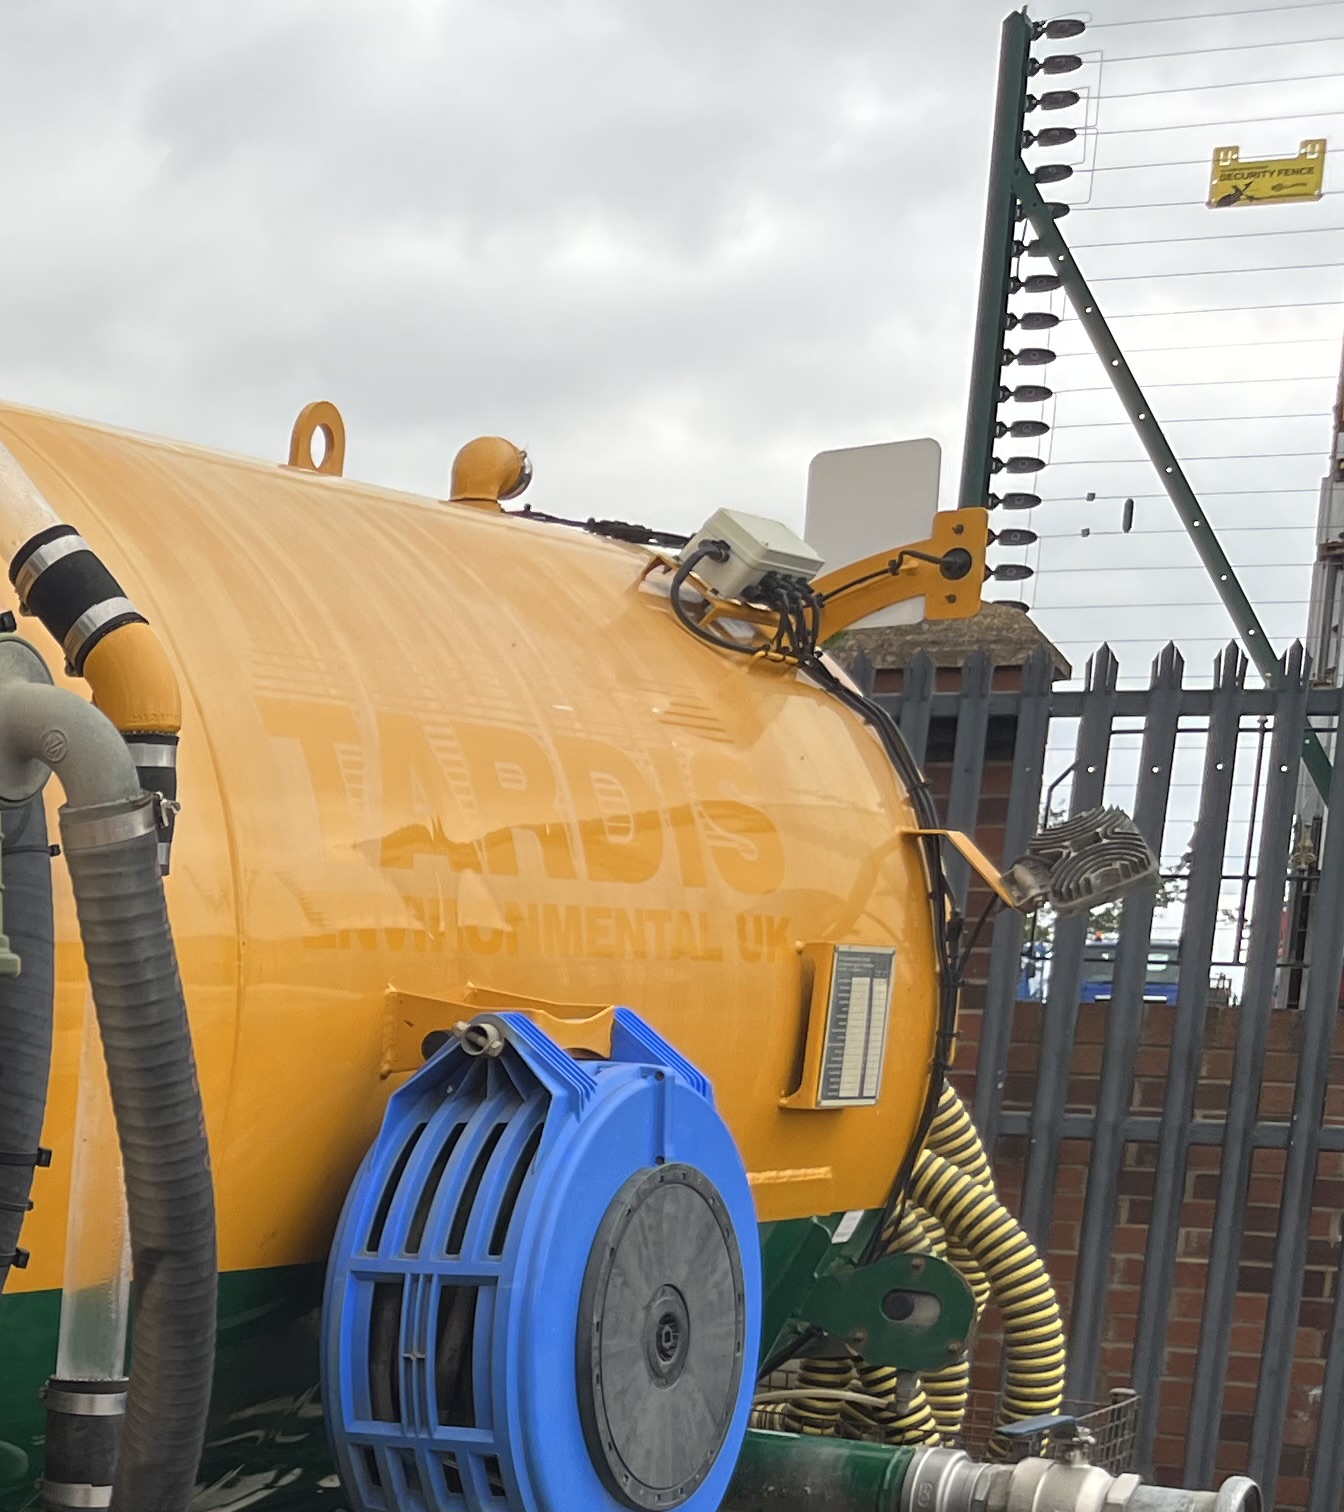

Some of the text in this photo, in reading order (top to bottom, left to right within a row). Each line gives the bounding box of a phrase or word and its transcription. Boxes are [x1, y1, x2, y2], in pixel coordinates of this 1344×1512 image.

[1219, 168, 1276, 182] SECURITY
[1277, 166, 1315, 178] FENCE
[253, 696, 786, 896] TARDIS
[736, 913, 792, 965] UK
